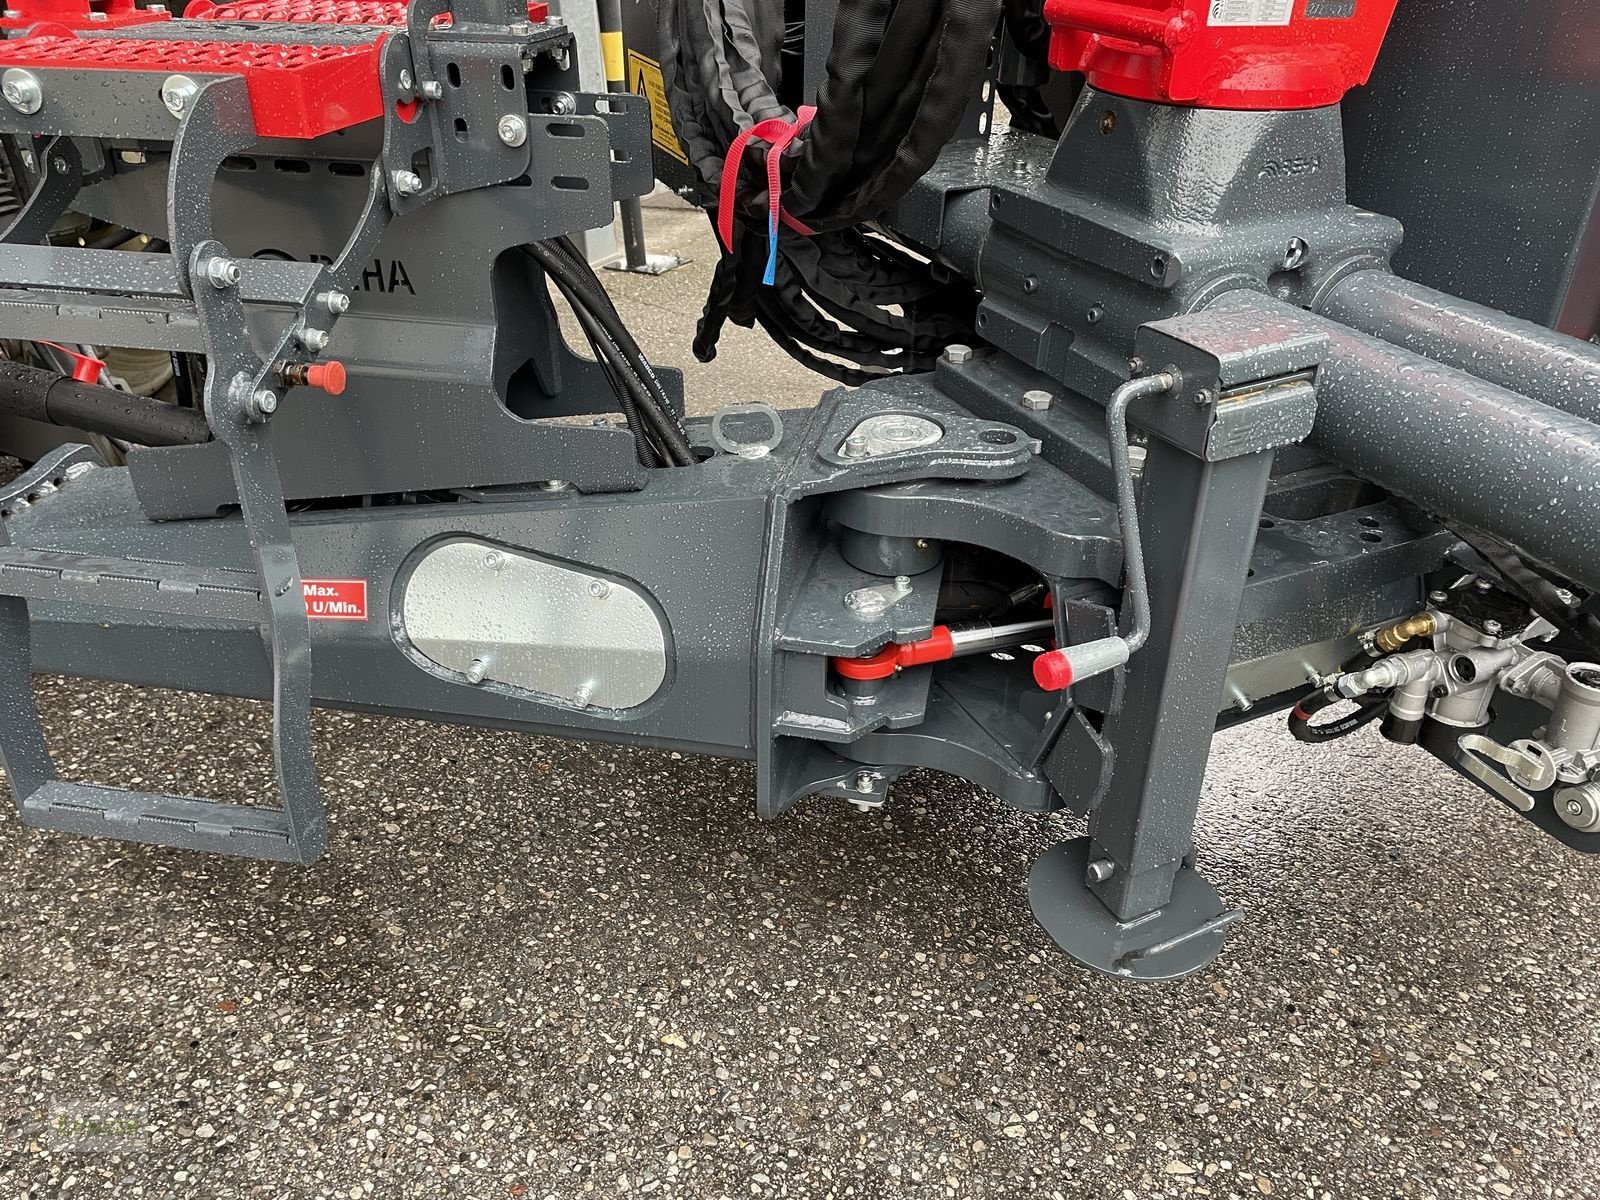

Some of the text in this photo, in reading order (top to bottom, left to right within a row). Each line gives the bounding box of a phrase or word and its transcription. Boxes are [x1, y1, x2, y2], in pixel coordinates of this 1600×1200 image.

[638, 353, 655, 379] WABCO
[303, 584, 339, 596] Max.
[312, 601, 362, 614] U/Min.
